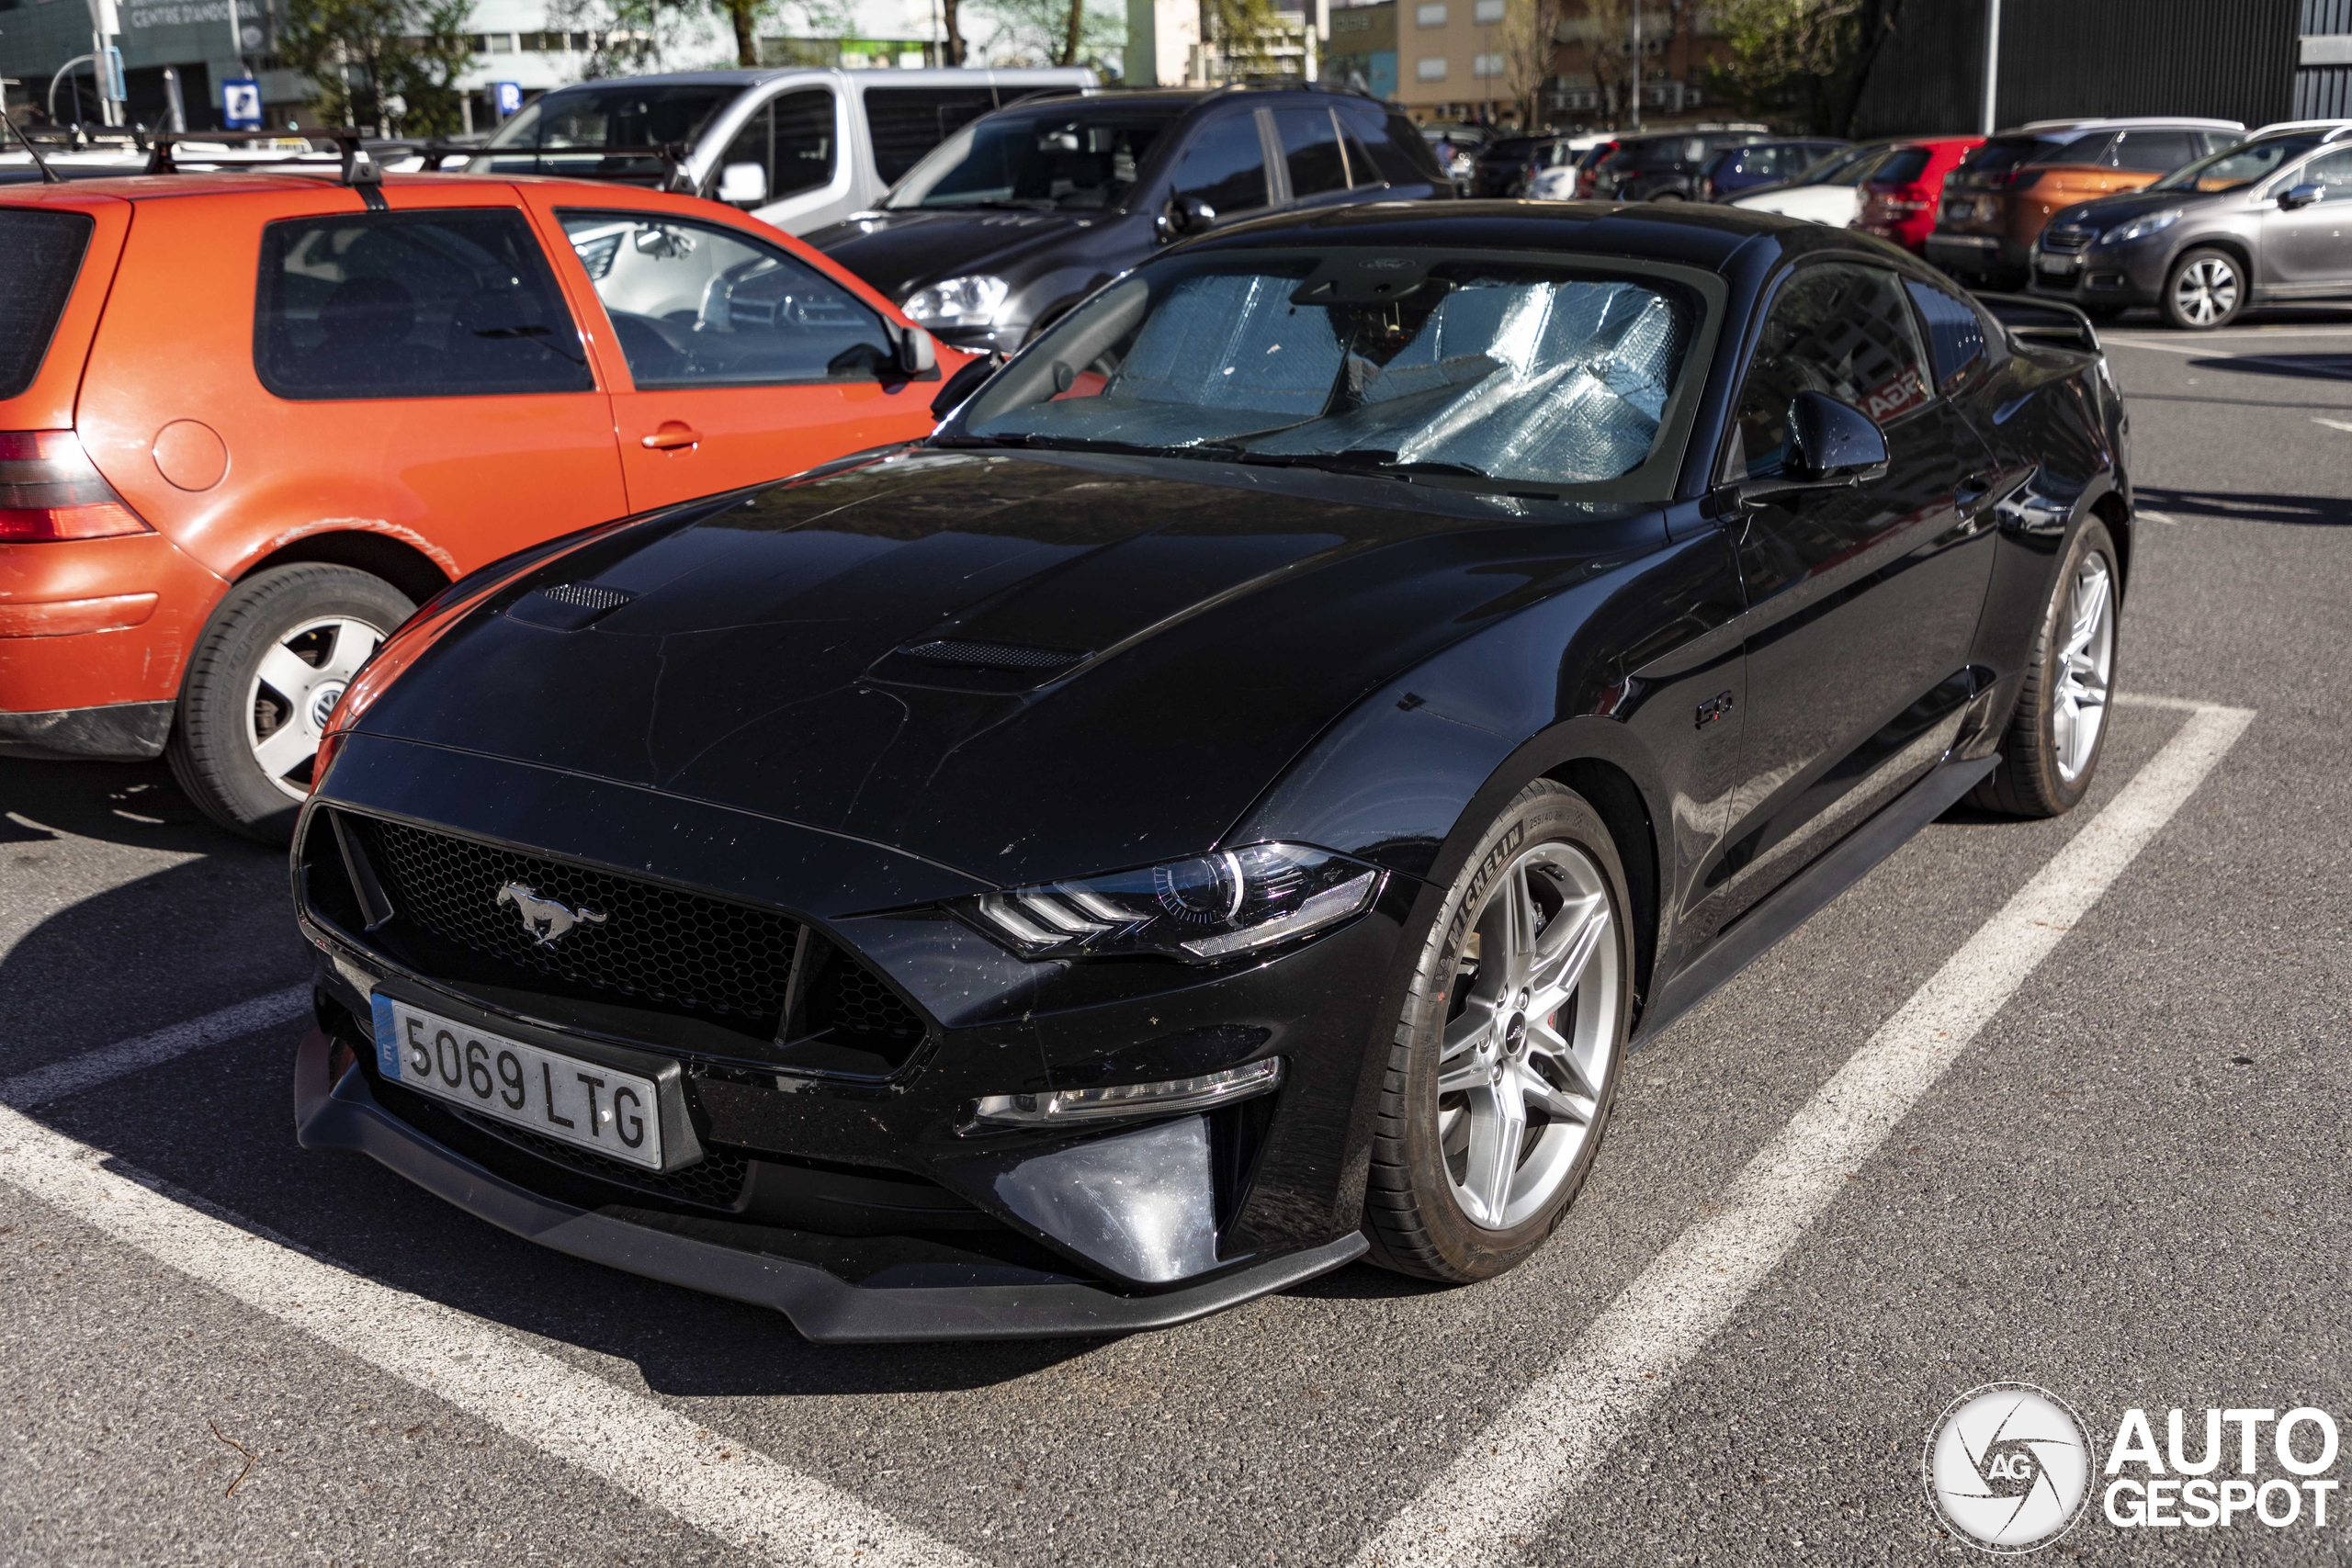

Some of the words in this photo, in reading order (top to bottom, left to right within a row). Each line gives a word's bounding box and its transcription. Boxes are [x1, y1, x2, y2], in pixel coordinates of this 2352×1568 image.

[131, 6, 181, 28] CENTRE
[182, 0, 261, 24] D'ANDORA
[1529, 811, 1553, 829] 255/40
[1448, 826, 1520, 950] MICHELIN
[382, 1043, 393, 1062] E
[405, 1016, 526, 1111] 5069
[542, 1062, 644, 1149] LTG
